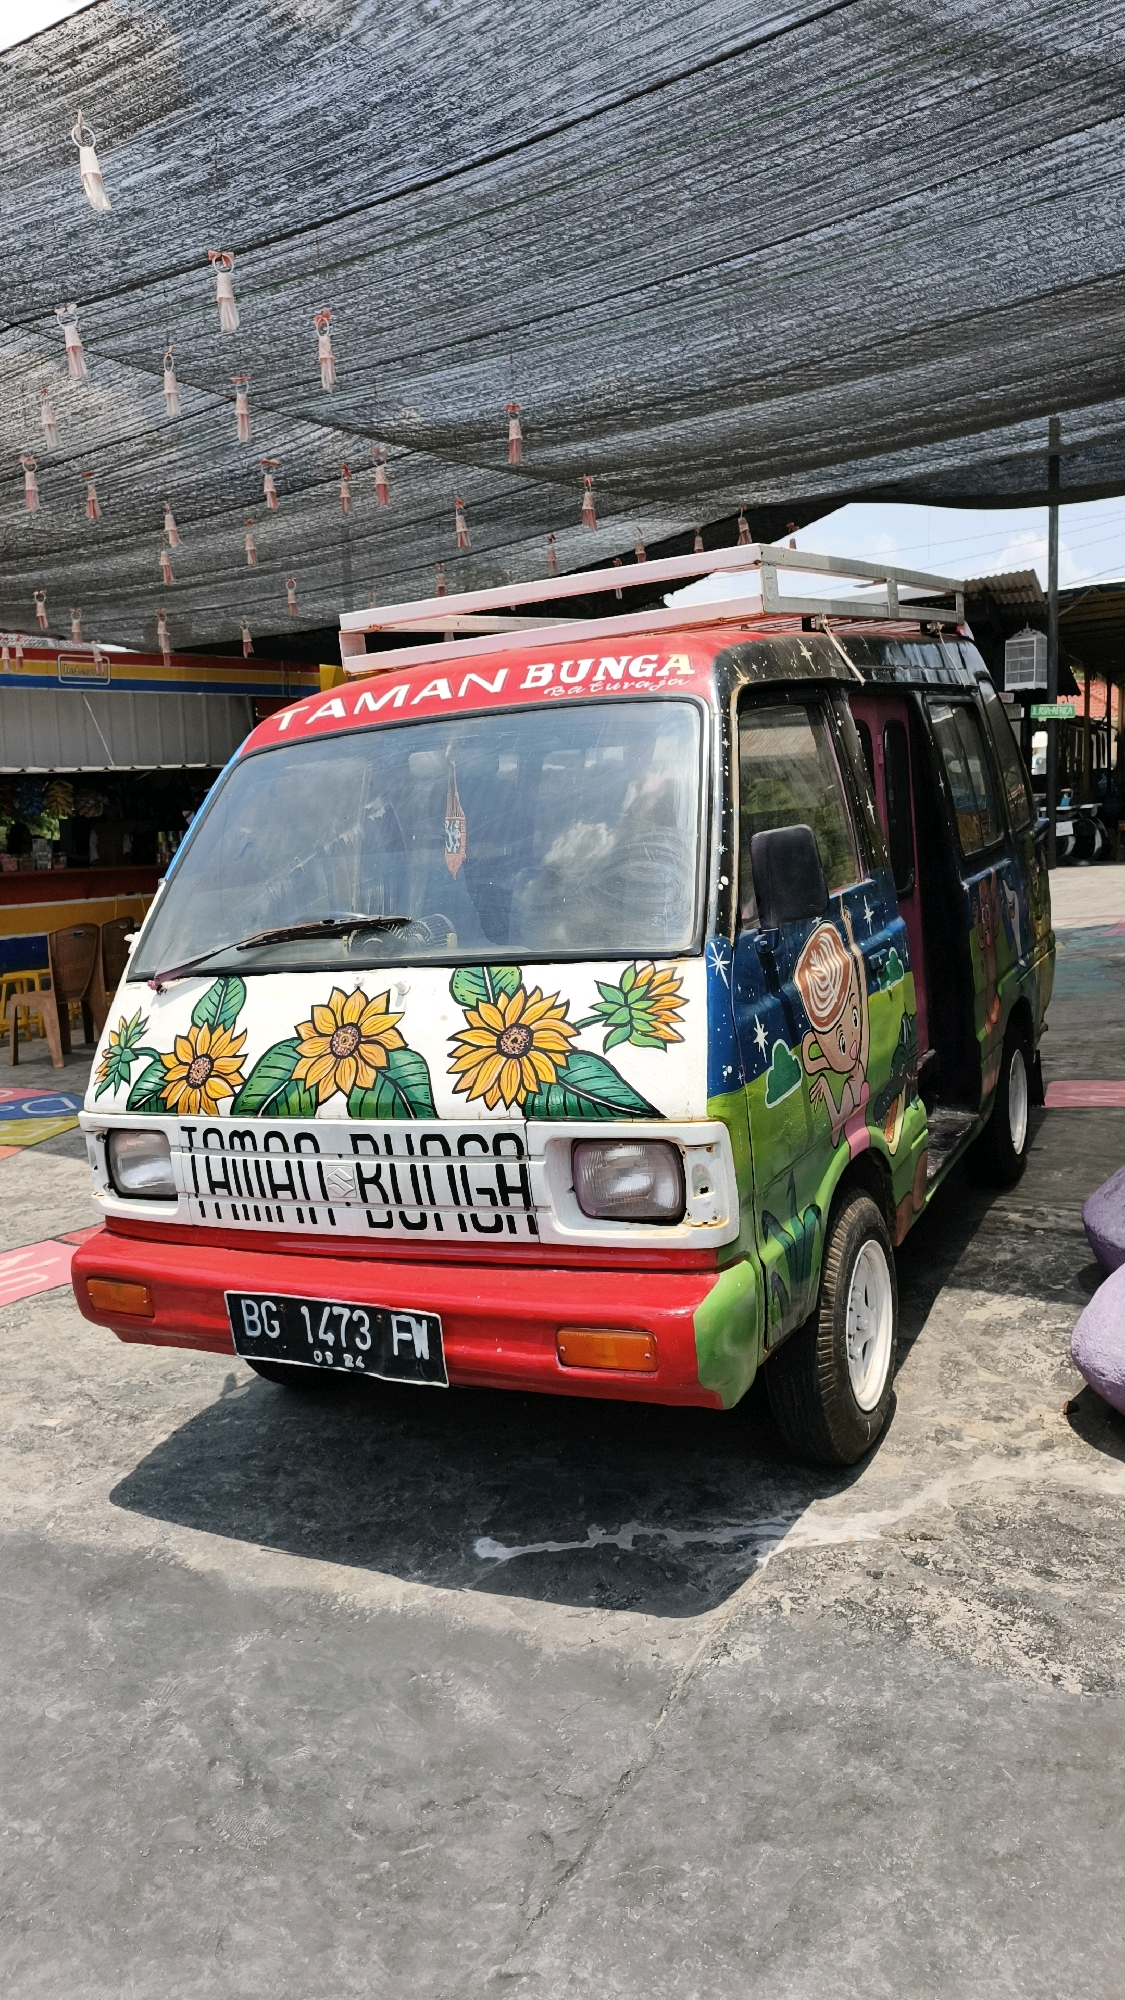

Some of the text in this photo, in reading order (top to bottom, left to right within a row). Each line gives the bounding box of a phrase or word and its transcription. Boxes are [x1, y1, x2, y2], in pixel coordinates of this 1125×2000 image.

[273, 653, 695, 732] TAMAN BUNGA
[543, 676, 691, 697] Baturaja
[349, 1132, 539, 1235] BUNGA
[240, 1299, 281, 1338] BG
[300, 1305, 372, 1351] 1473
